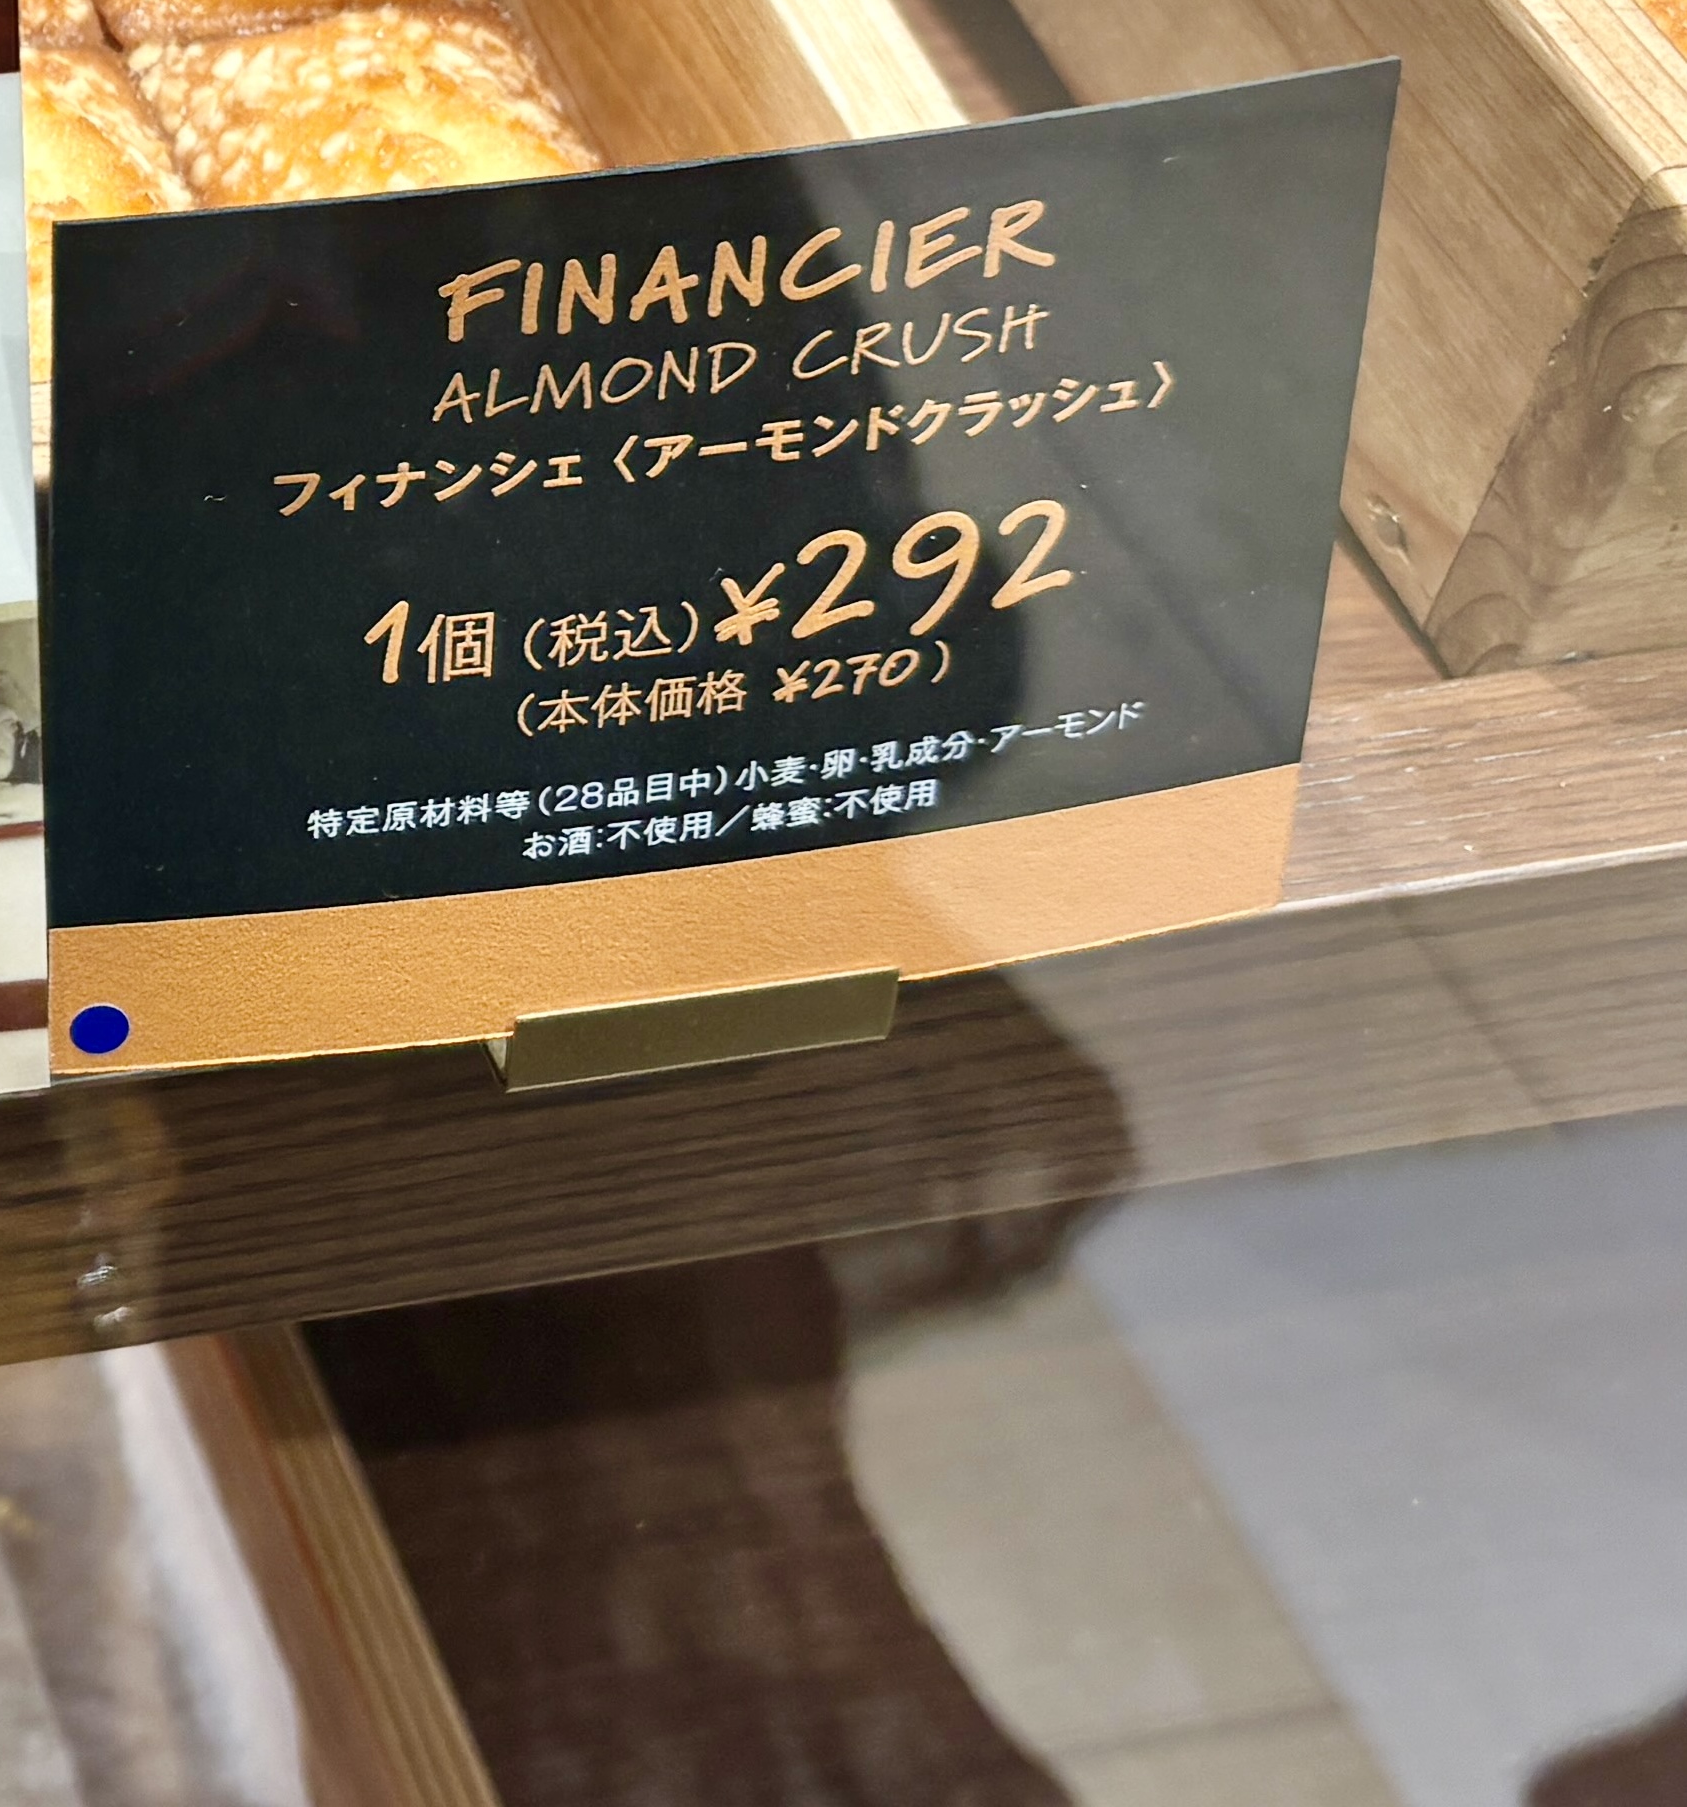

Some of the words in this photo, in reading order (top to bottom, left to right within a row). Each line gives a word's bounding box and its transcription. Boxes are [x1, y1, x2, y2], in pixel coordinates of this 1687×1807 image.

[439, 199, 1057, 343] FINANCIER
[435, 342, 758, 424] ALMOND
[794, 306, 1049, 380] CRUSH
[365, 601, 496, 685] 1個
